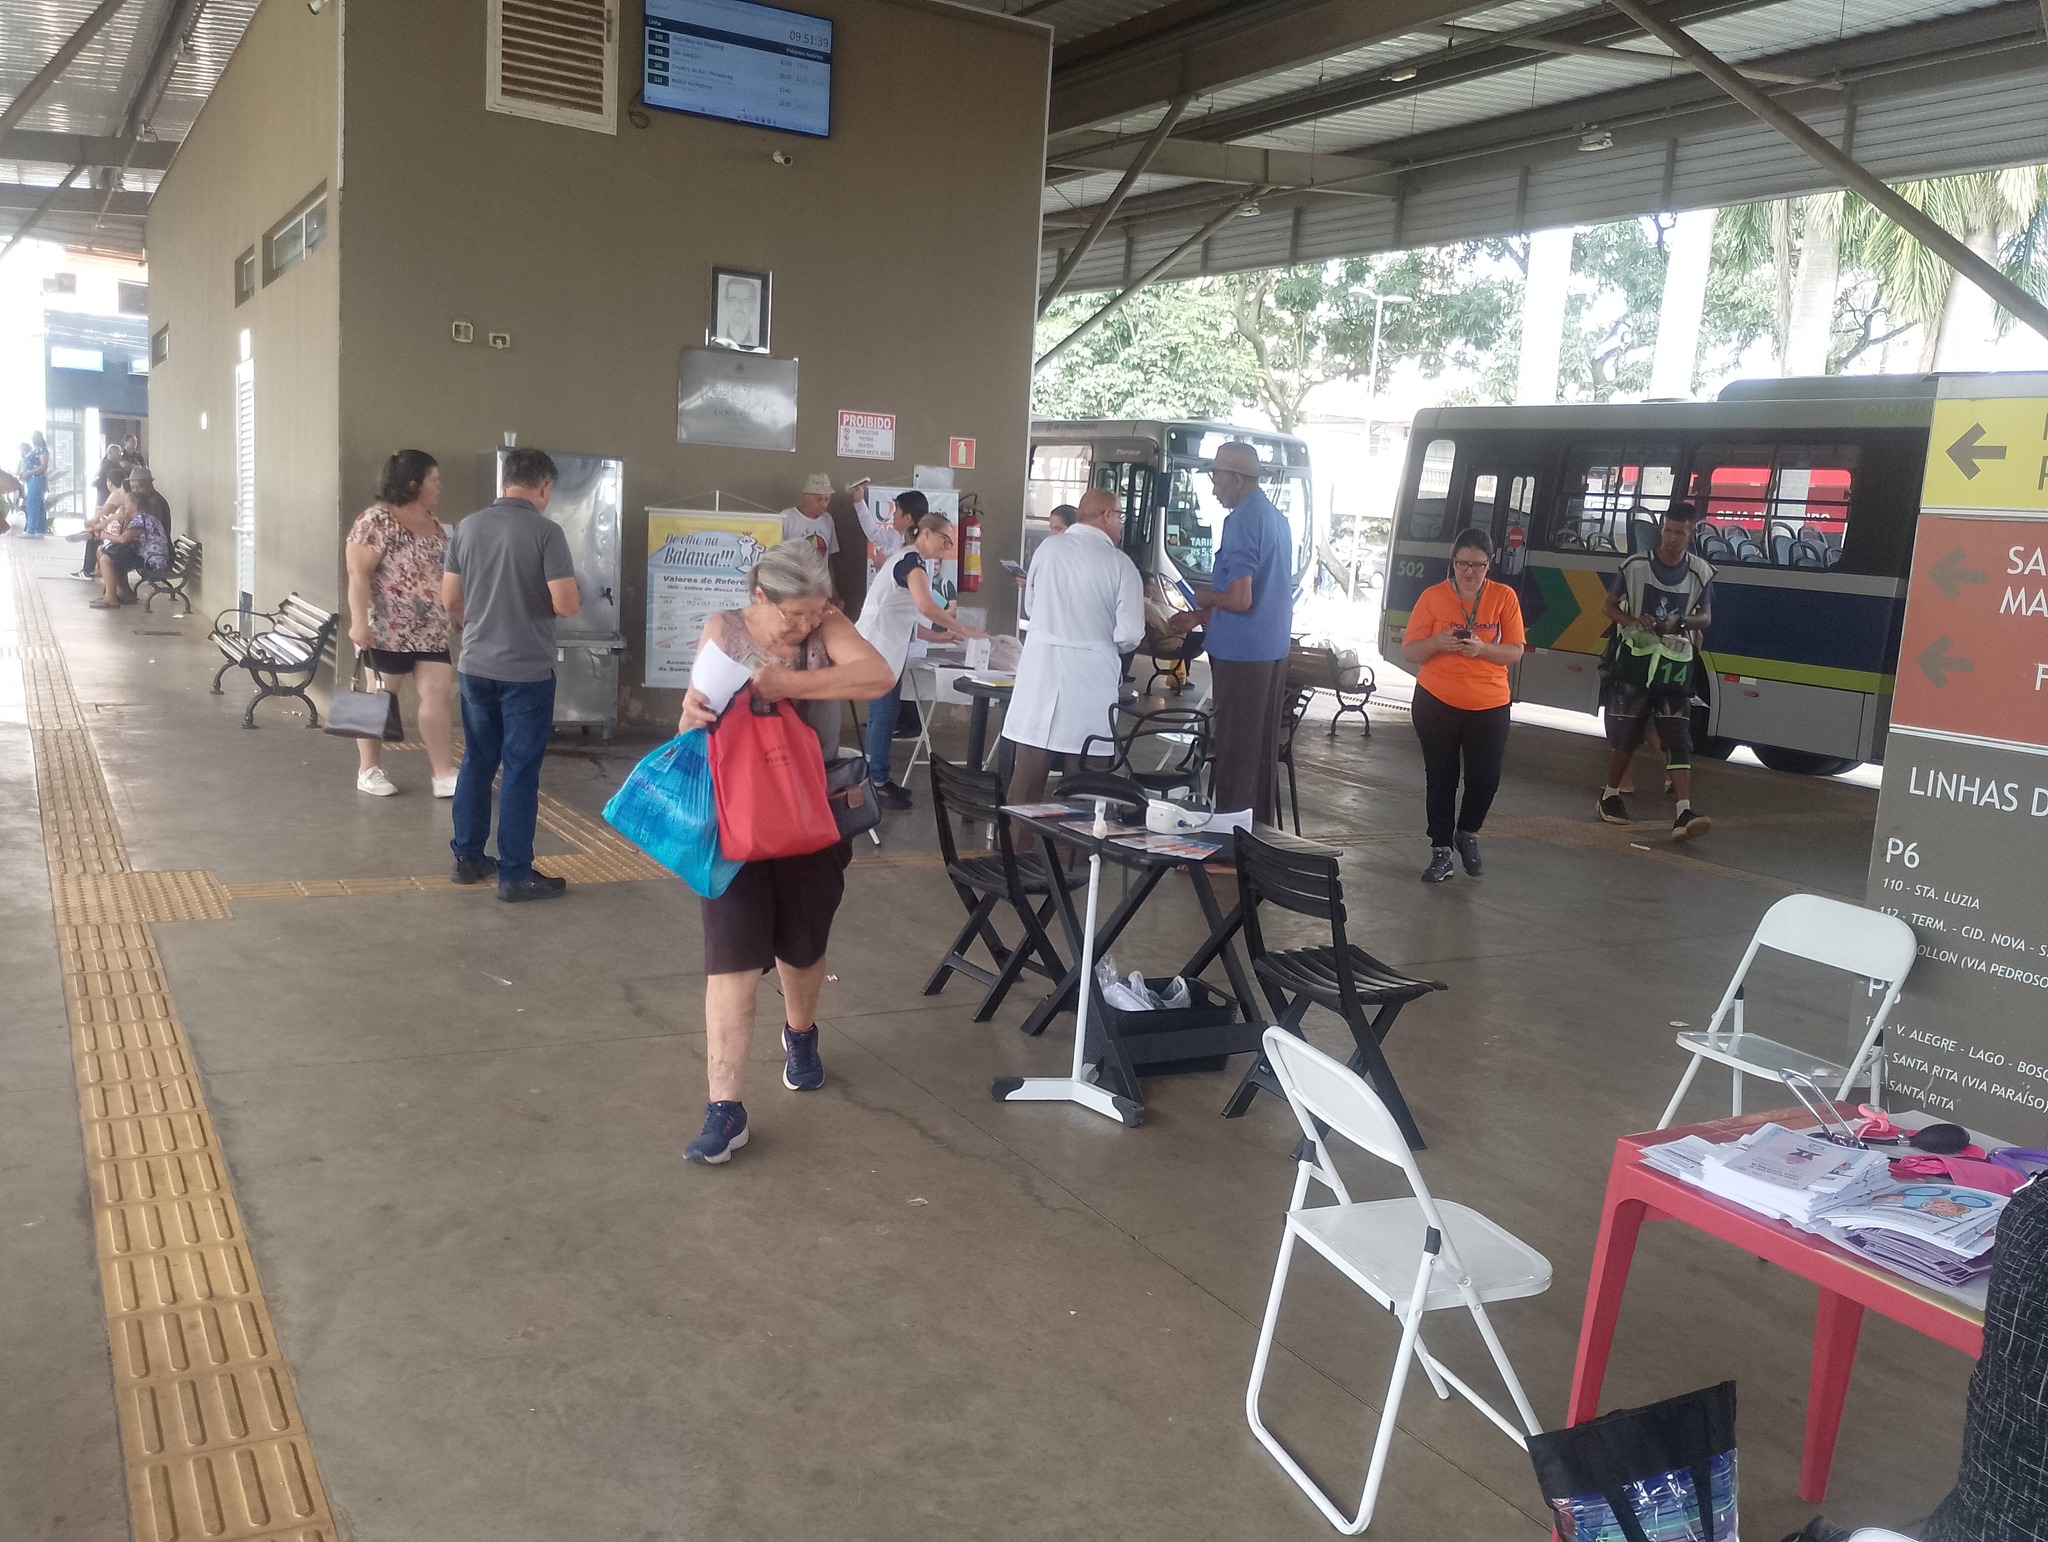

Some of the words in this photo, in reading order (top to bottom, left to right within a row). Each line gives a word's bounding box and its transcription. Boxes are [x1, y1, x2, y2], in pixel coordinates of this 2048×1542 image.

[789, 30, 829, 48] 09:51:39
[843, 413, 891, 430] PROIBIDO
[665, 533, 679, 545] De
[704, 537, 719, 547] na
[1189, 537, 1214, 547] TARIF
[1397, 559, 1425, 578] 502
[2006, 545, 2047, 576] SA
[663, 575, 698, 584] Valores
[700, 577, 713, 585] de
[714, 577, 745, 586] Referê
[1999, 585, 2048, 618] MA
[1660, 662, 1688, 686] 14
[1909, 766, 2019, 812] LINHAS
[1885, 837, 1920, 869] P6
[1883, 877, 1904, 891] 110
[1914, 884, 1939, 900] STA.
[1943, 890, 1980, 910] LUZIA
[1911, 912, 1947, 932] TERM.
[1961, 925, 1986, 942] CID.
[1990, 932, 2026, 952] NOVA
[1917, 944, 1959, 965] OLLON
[1961, 956, 1987, 973] (VIA
[1989, 963, 2048, 988] PEDROSO
[1896, 1023, 1906, 1037] V.
[1909, 1029, 1958, 1053] ALEGRE
[1968, 1046, 2005, 1066] LAGO
[1891, 1052, 1929, 1074] SANTA
[1932, 1064, 1959, 1083] RITA
[1962, 1075, 1987, 1093] (VIA
[1888, 1079, 1925, 1102] SANTA
[1928, 1092, 1955, 1112] RITA
